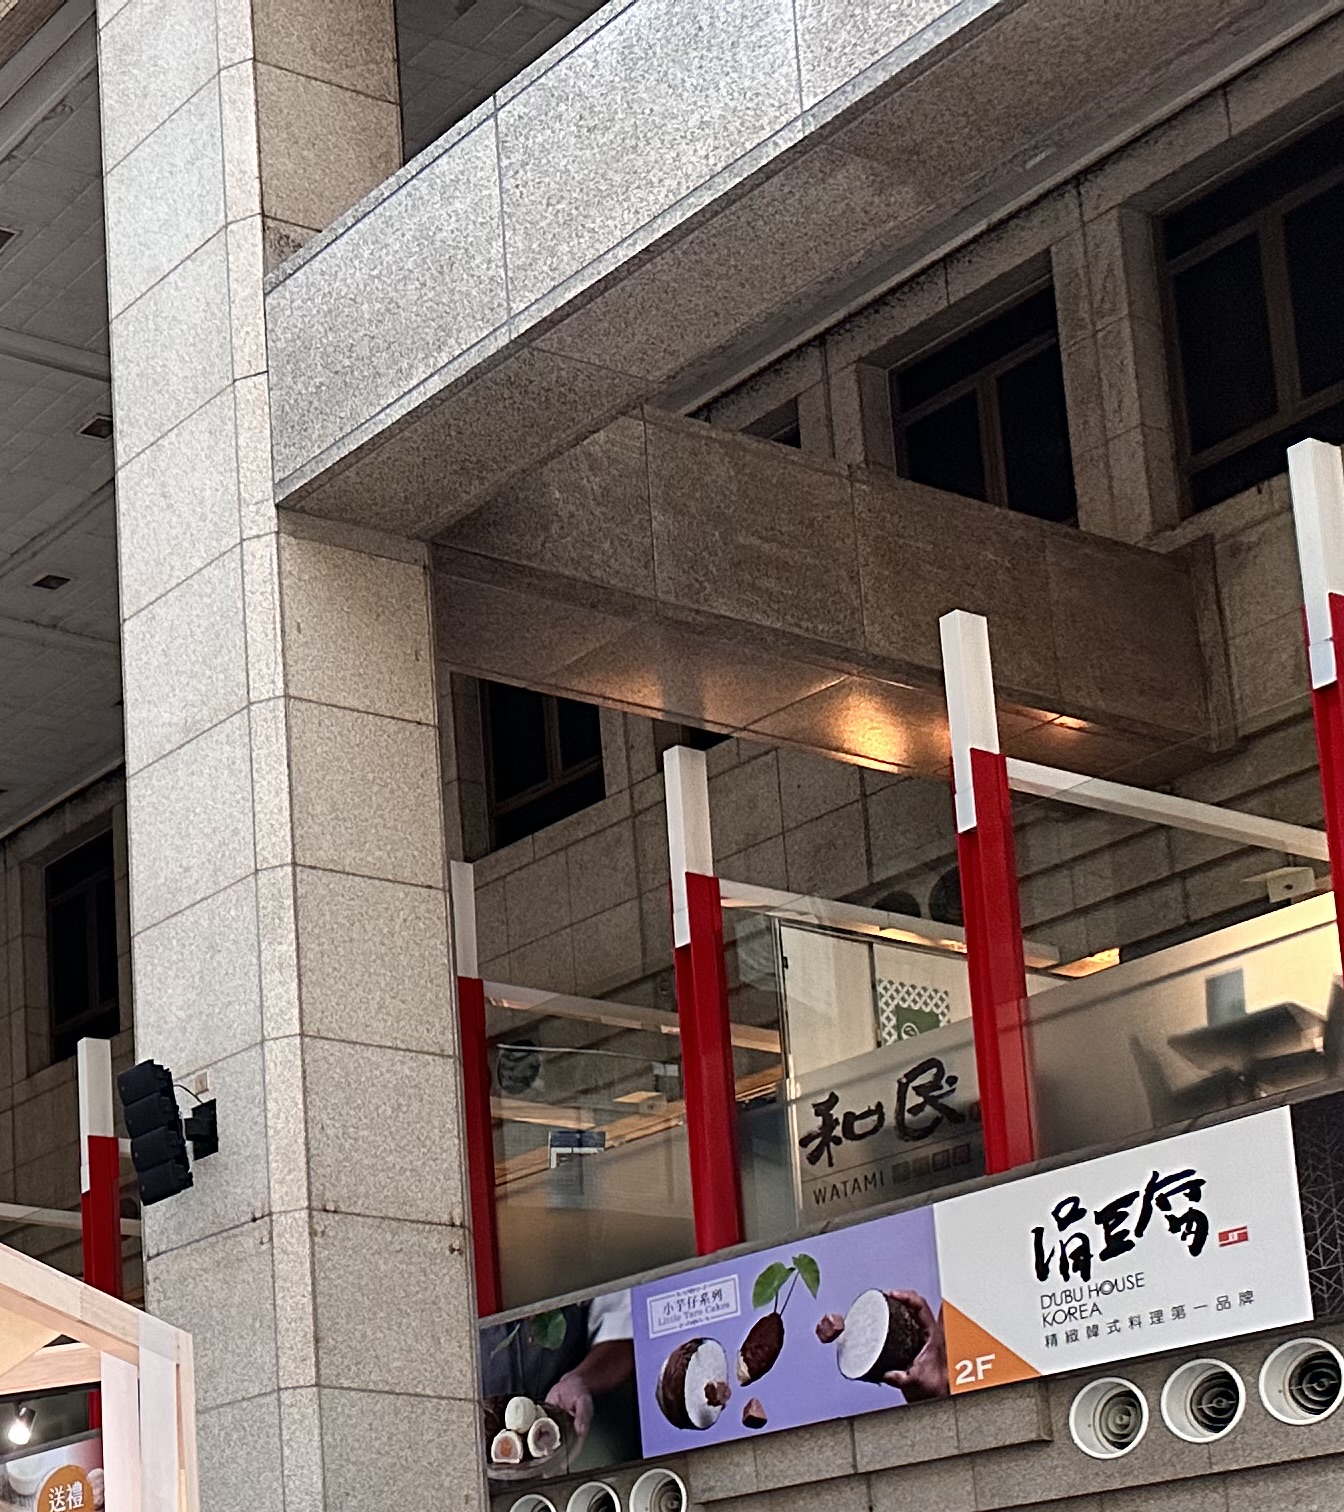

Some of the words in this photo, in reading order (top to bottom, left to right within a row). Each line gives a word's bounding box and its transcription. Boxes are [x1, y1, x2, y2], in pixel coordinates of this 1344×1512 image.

[799, 1057, 965, 1168] 和民
[813, 1170, 885, 1206] WATAMI
[1040, 1288, 1085, 1310] DUBU
[1087, 1271, 1146, 1298] HOUSE
[1041, 1301, 1104, 1328] KOREA
[954, 1352, 996, 1386] 2F
